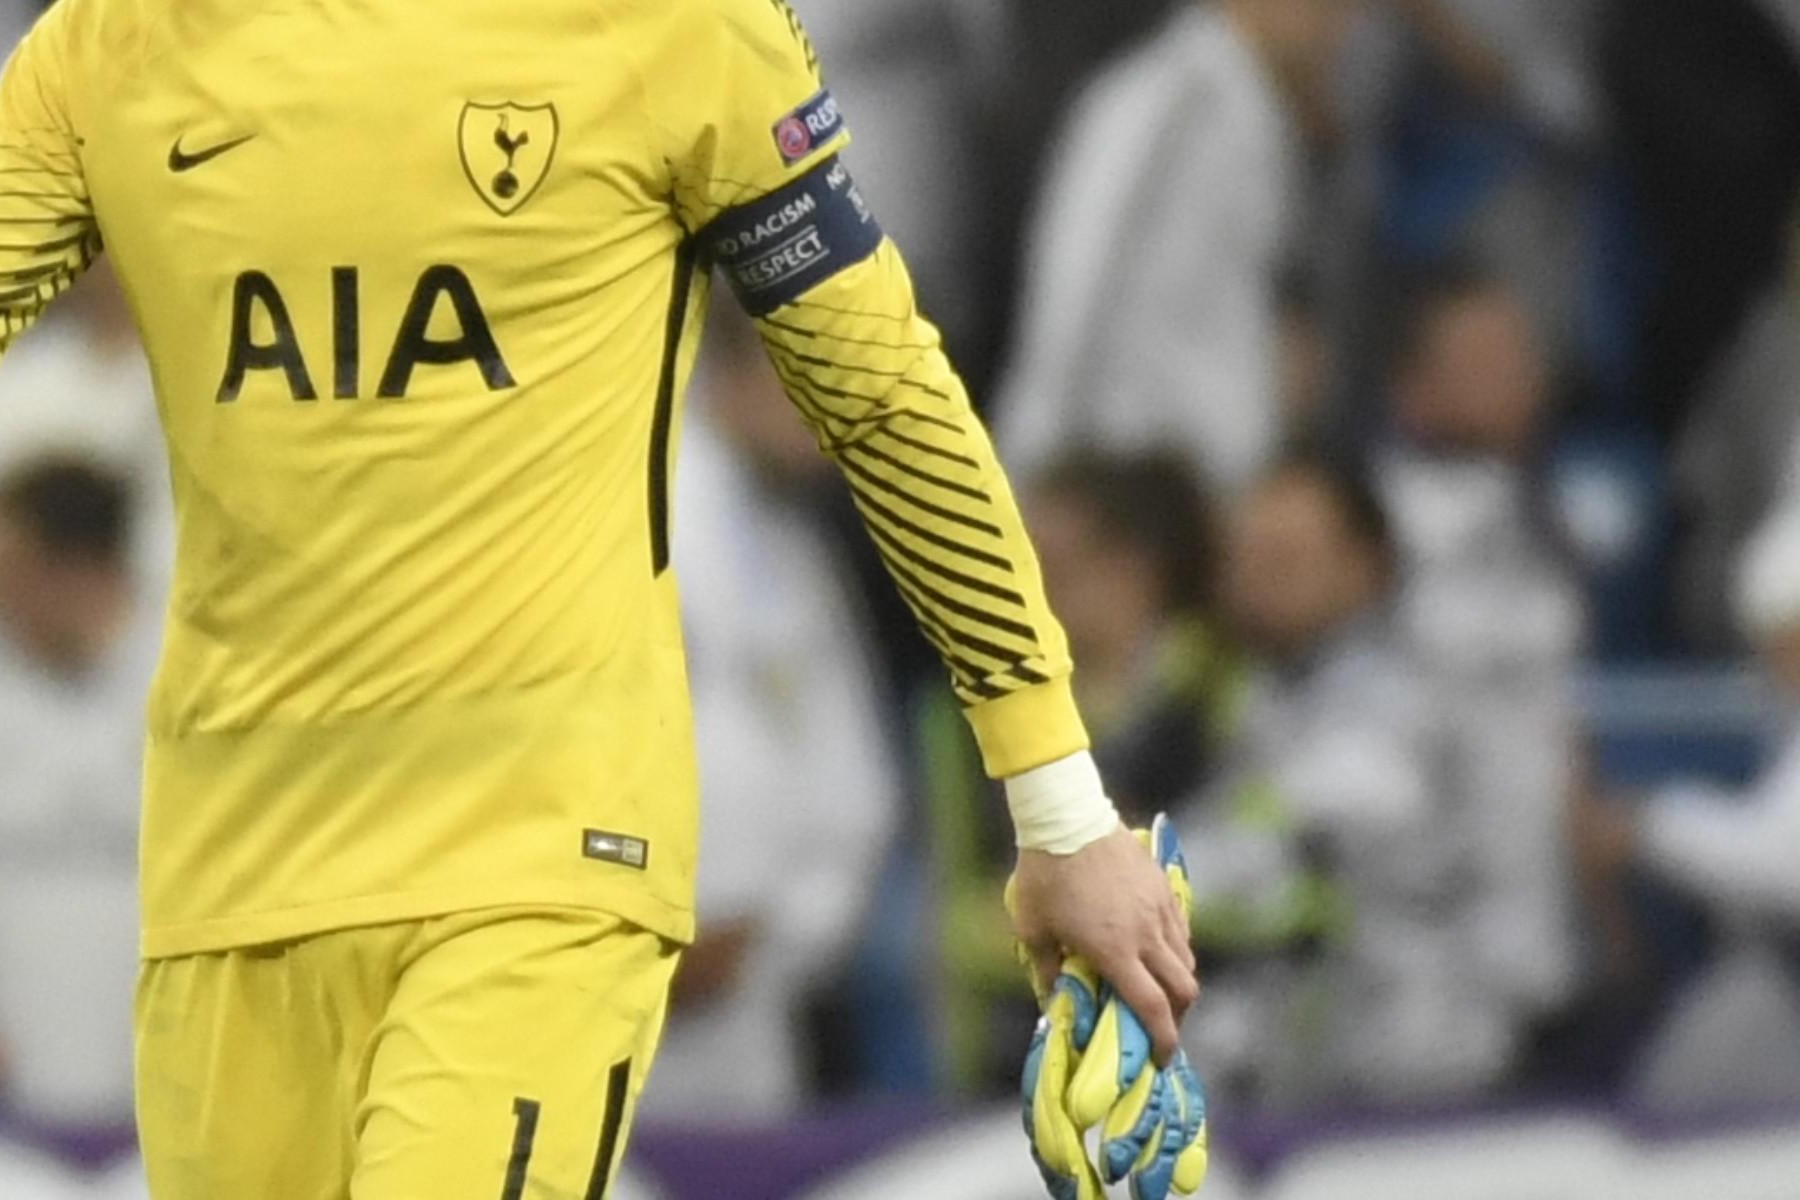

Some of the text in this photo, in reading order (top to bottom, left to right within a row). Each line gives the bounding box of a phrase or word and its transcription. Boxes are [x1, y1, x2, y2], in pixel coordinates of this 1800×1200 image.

[739, 191, 817, 247] RACISM
[215, 263, 519, 404] AIA
[501, 1096, 541, 1200] 1
